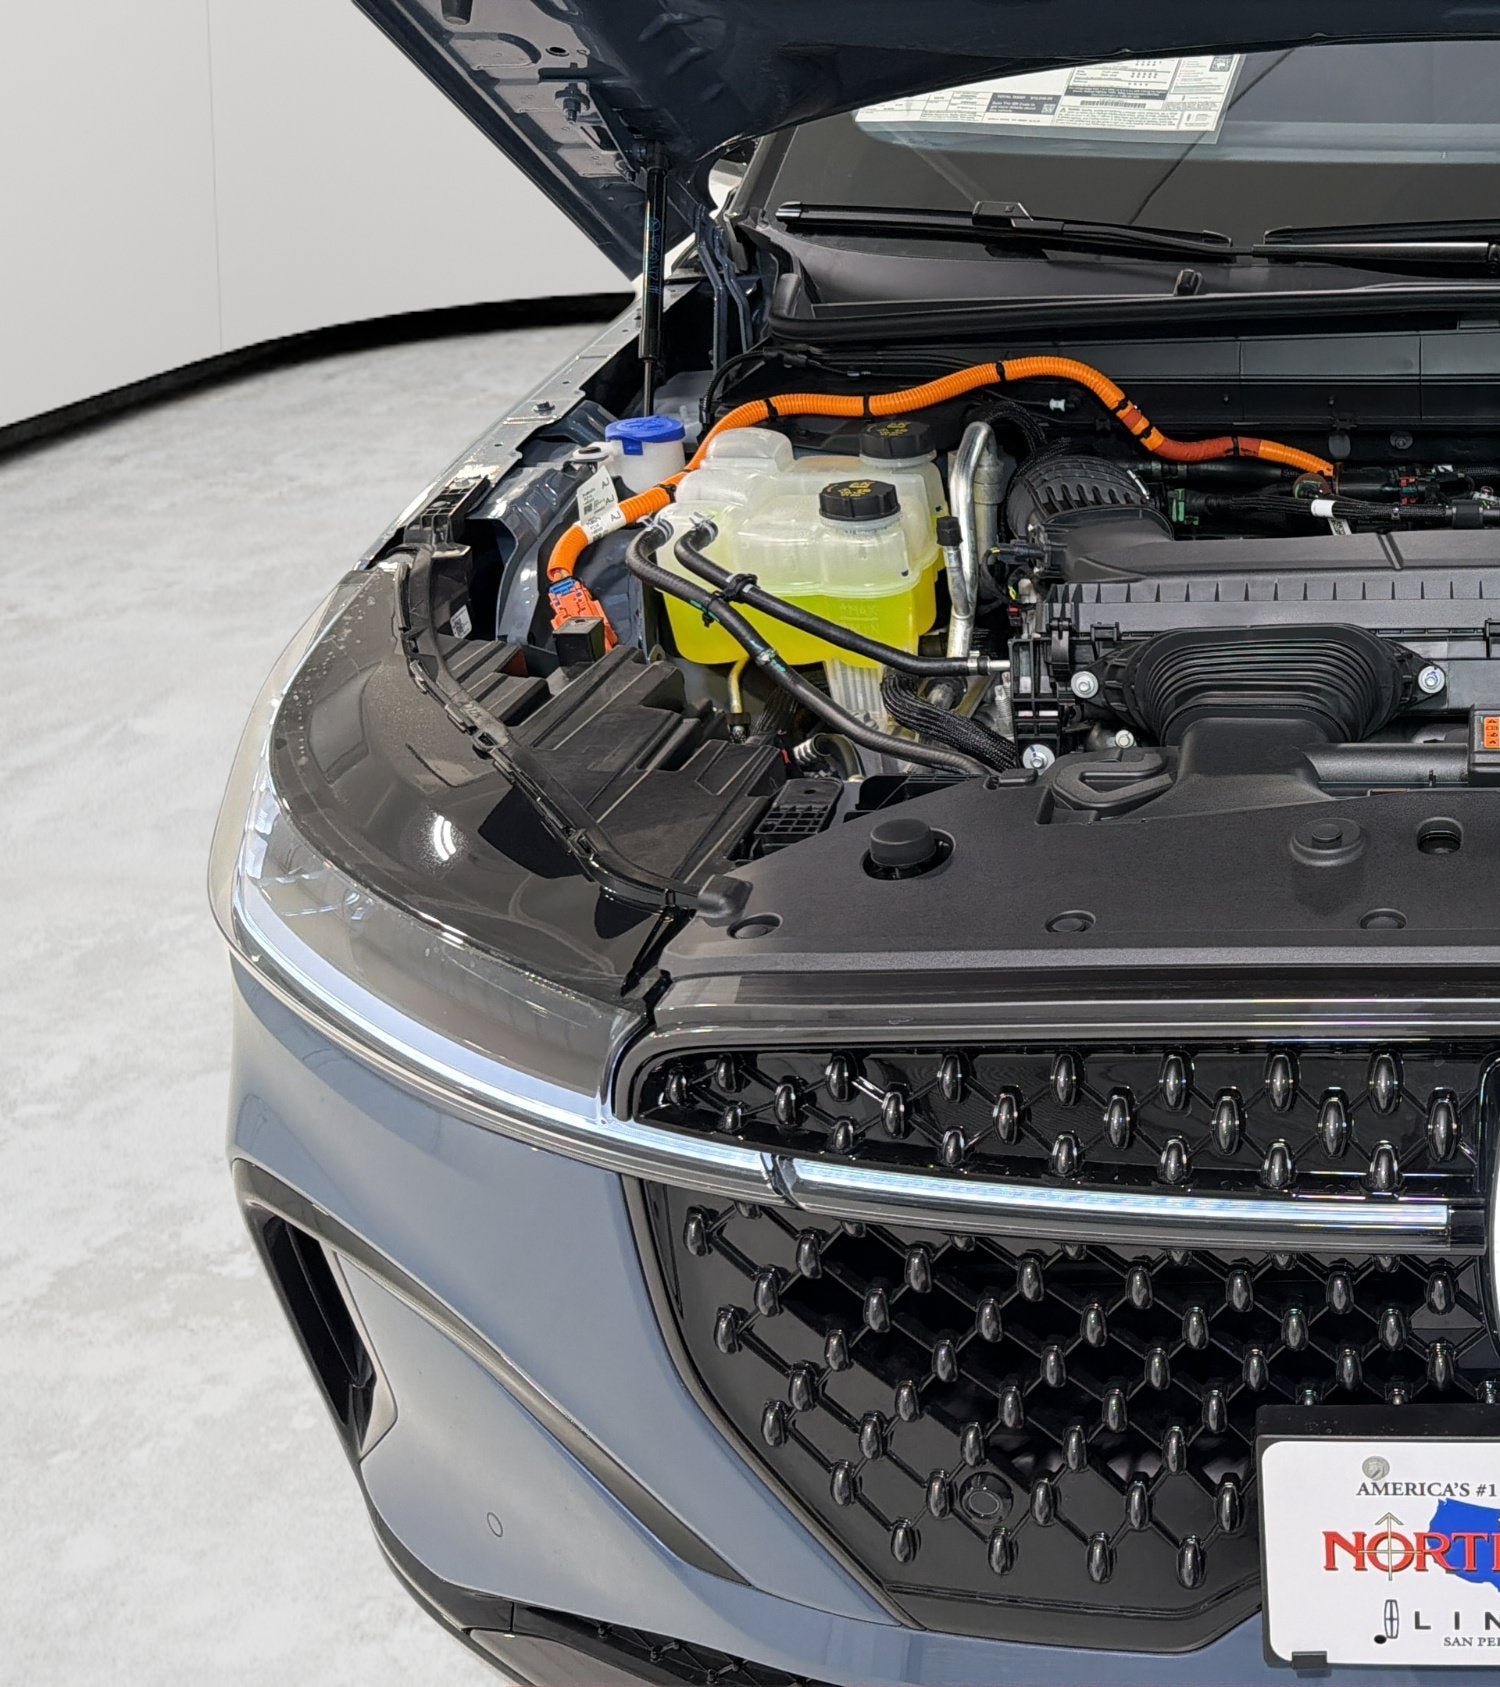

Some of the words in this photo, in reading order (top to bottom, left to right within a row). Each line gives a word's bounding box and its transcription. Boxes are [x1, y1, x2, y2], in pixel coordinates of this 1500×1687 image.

[610, 510, 622, 521] AJ
[1355, 1481, 1471, 1498] AMERICA'S
[1476, 1483, 1499, 1498] #1
[1443, 1636, 1474, 1648] SAN
